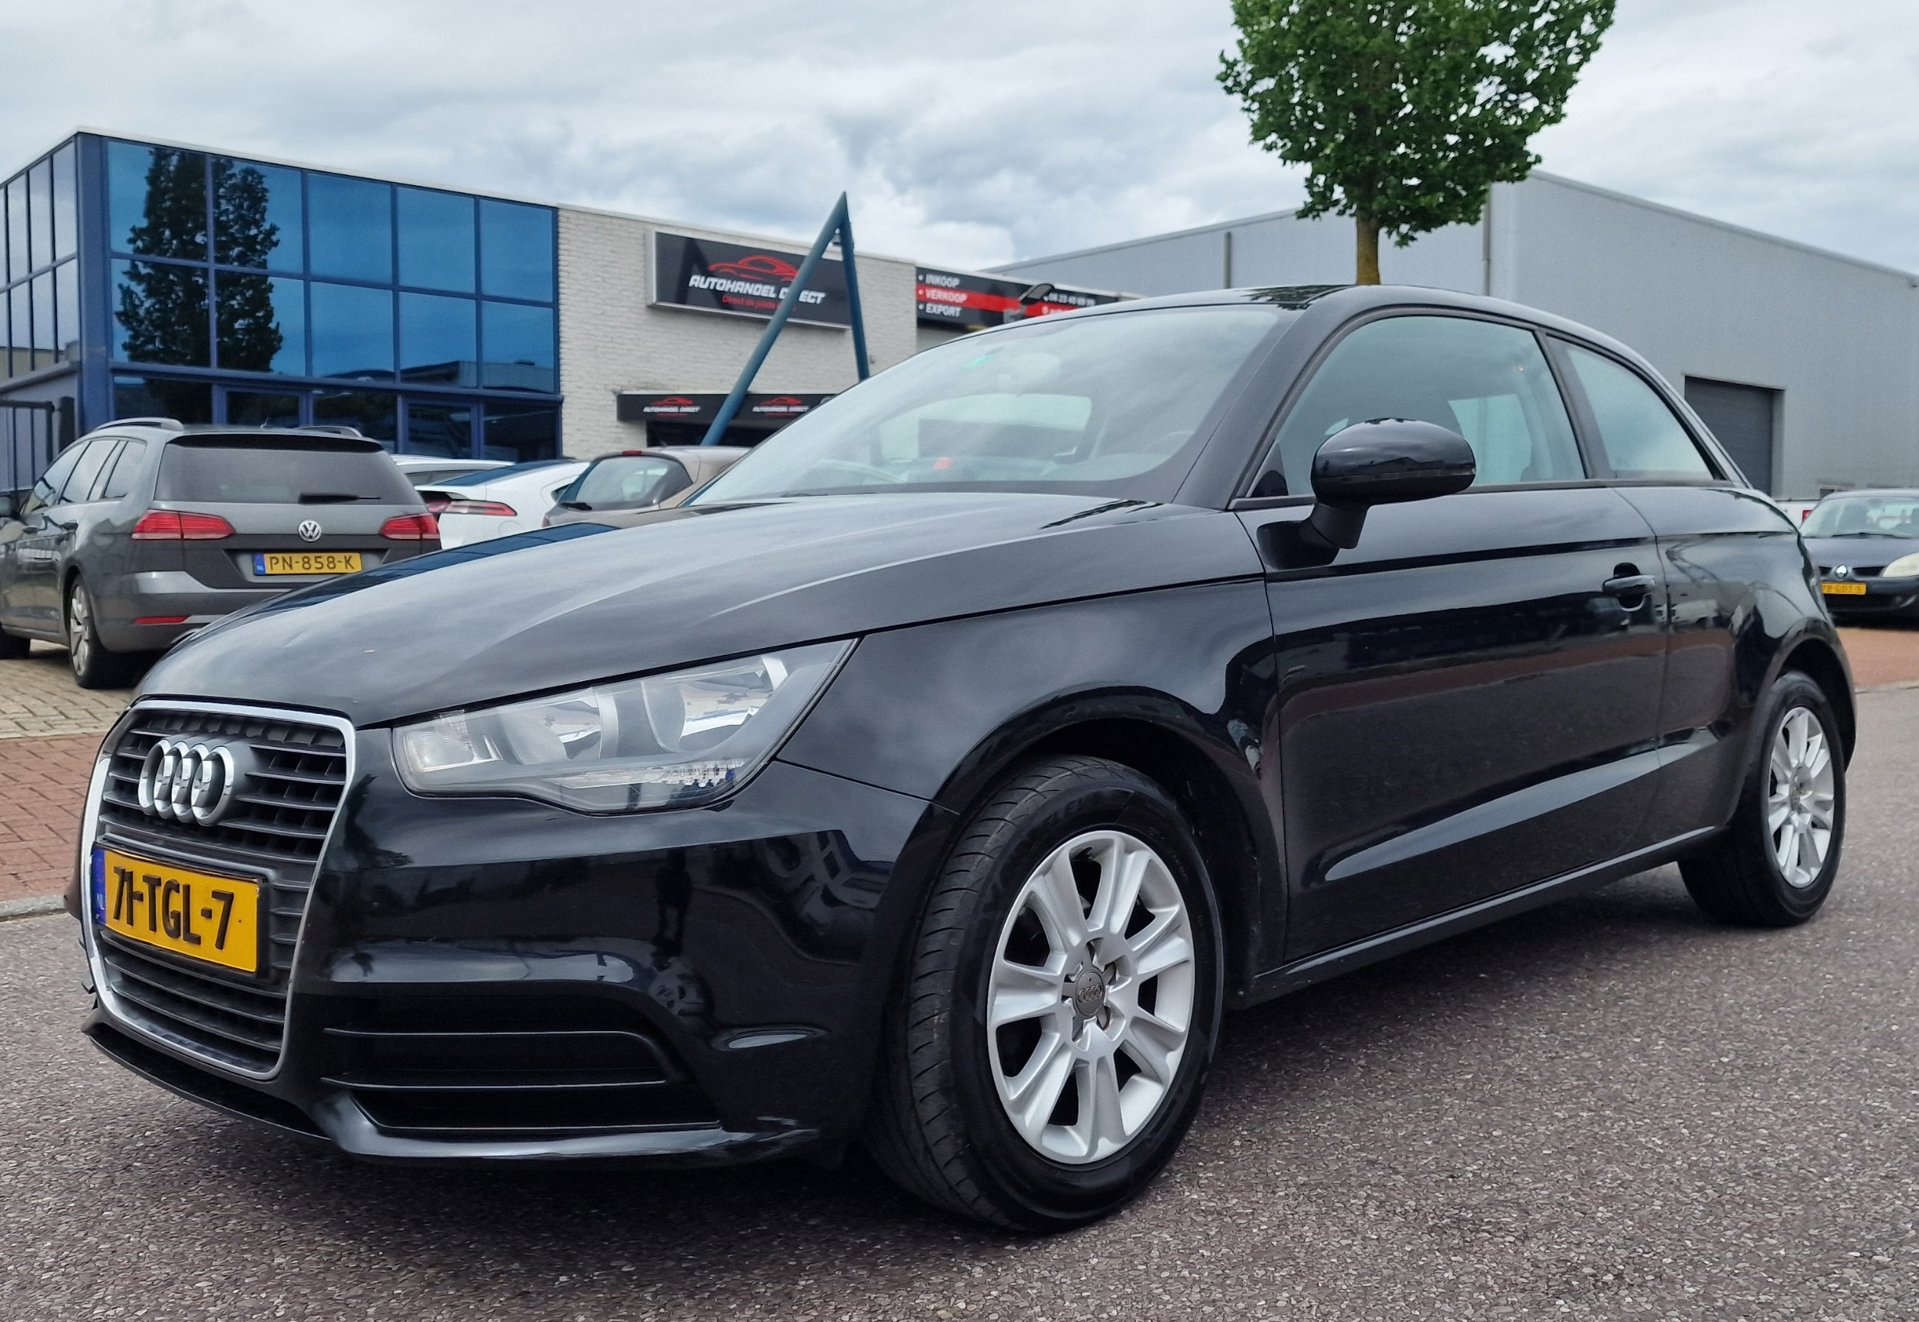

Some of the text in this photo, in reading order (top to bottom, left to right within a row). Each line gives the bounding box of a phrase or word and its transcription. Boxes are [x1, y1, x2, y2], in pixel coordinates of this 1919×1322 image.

[925, 273, 960, 288] INKOOP
[688, 275, 826, 305] AUTOHANDEL DECT
[925, 288, 968, 304] VERKOOP
[925, 303, 962, 317] EXPORT
[269, 555, 355, 571] PN-858-K
[113, 866, 235, 950] 71-TGL-7
